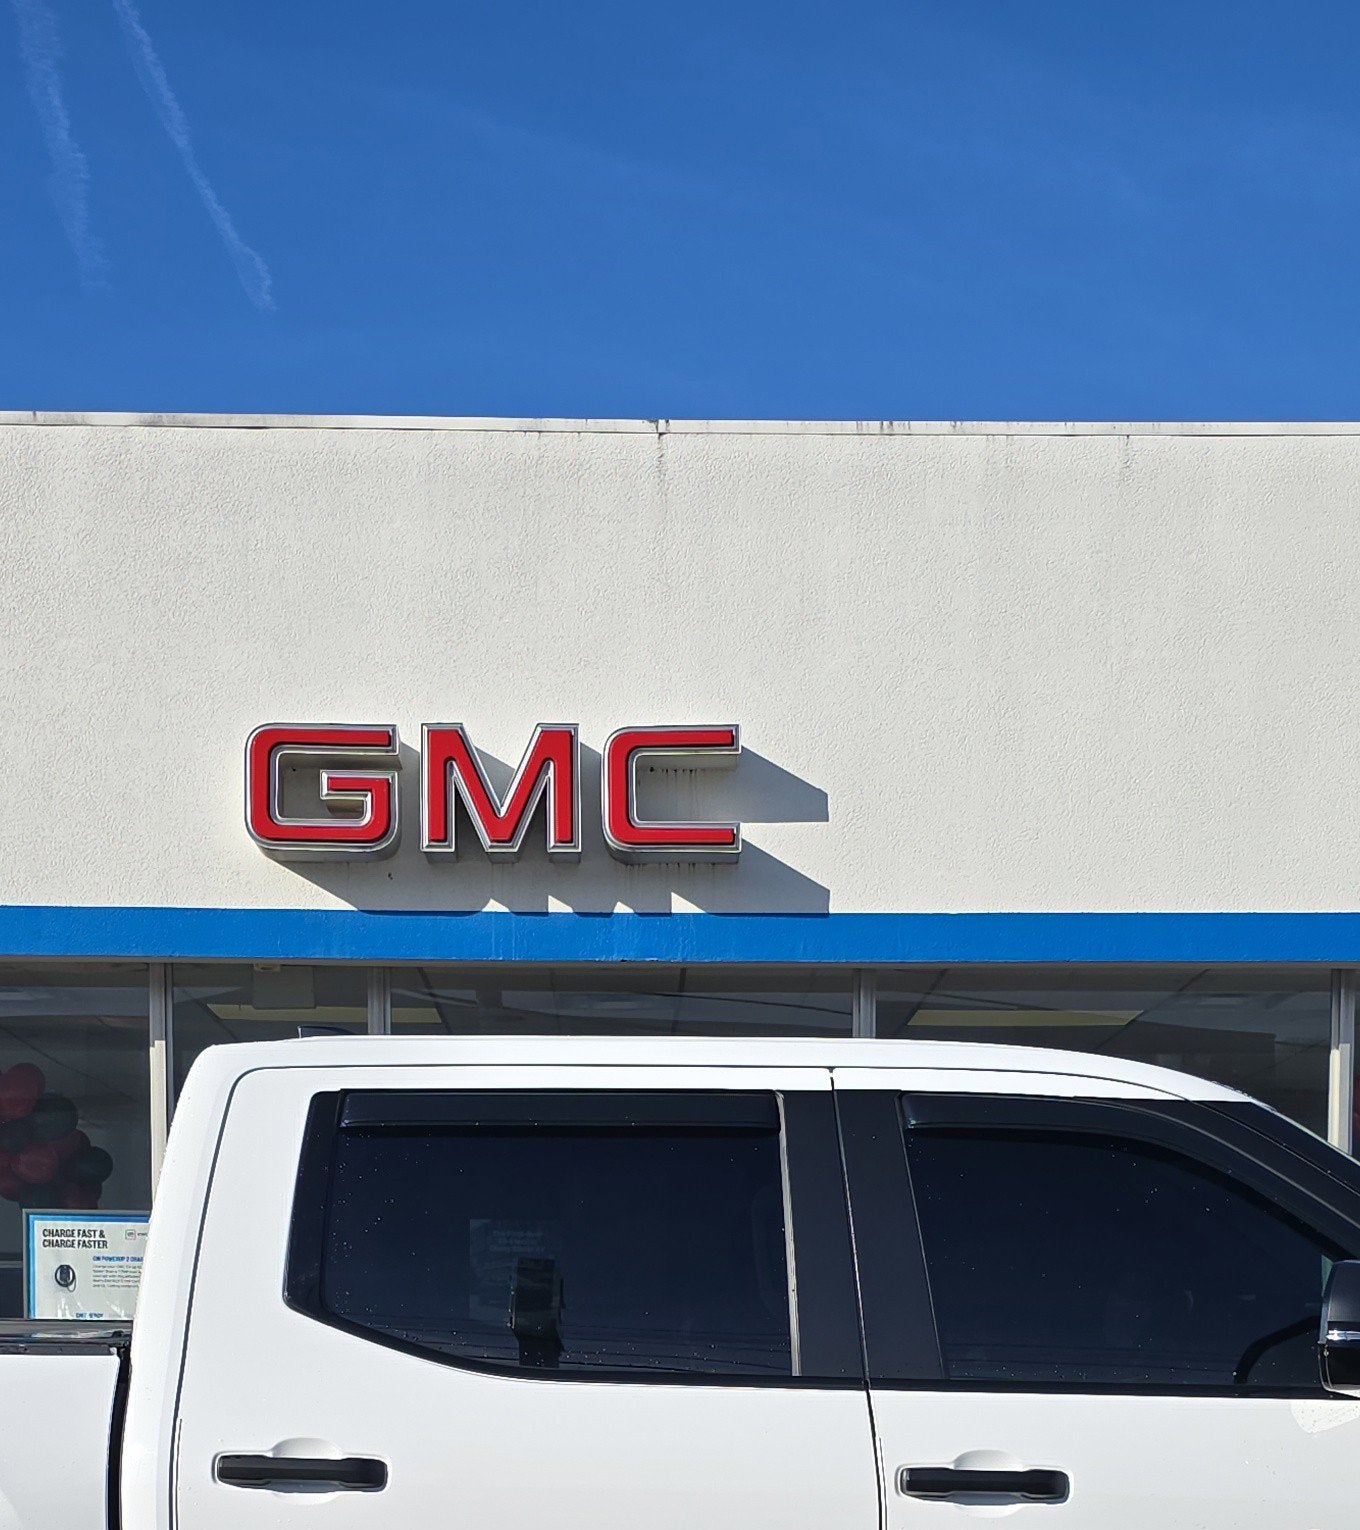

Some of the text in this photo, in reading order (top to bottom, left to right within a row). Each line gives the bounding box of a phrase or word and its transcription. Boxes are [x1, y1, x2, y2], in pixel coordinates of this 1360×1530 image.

[245, 722, 742, 858] GMC
[42, 1228, 106, 1238] CHARGE FAST &
[42, 1239, 108, 1249] CHARGE FASTER
